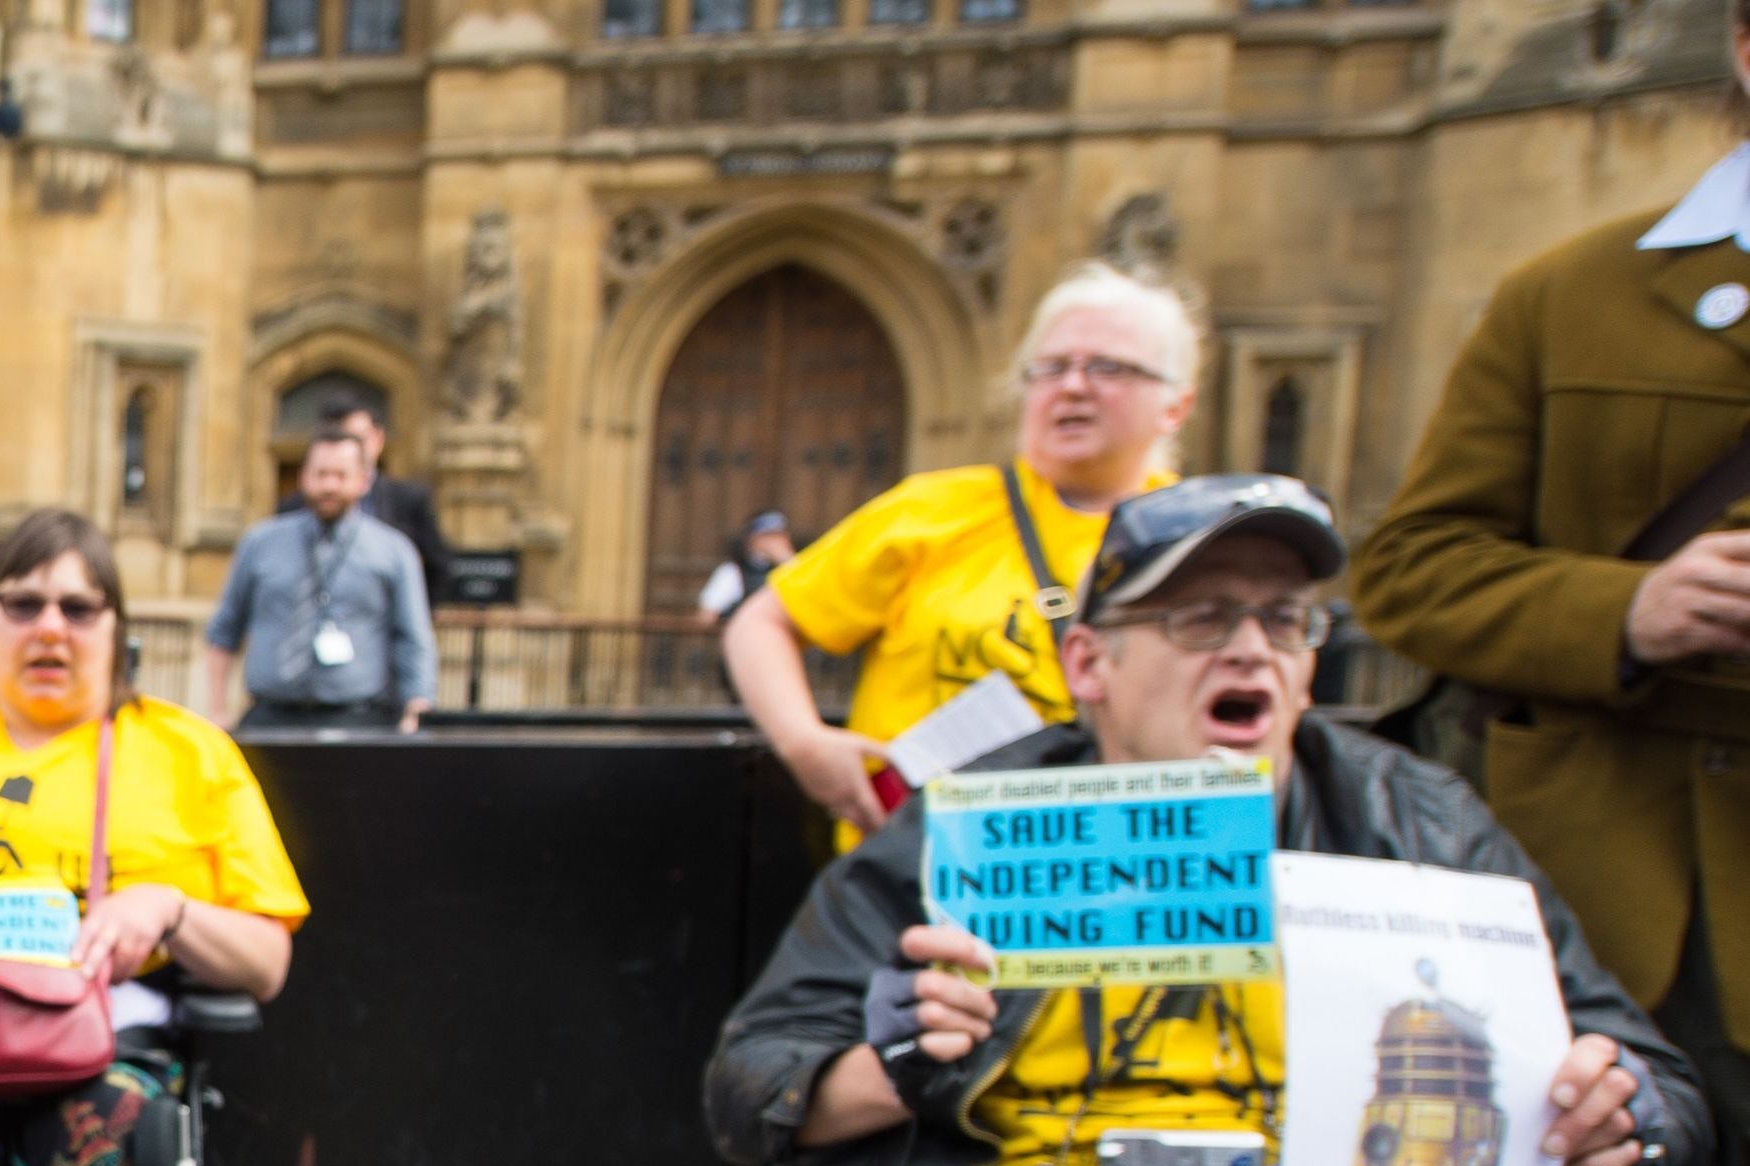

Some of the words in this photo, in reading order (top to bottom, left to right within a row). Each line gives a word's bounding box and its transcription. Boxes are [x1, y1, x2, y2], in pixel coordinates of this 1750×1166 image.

[1000, 774, 1061, 799] disabled
[1067, 773, 1122, 800] people
[1159, 768, 1194, 791] their
[1200, 765, 1262, 789] families
[982, 810, 1099, 851] SAVE
[1123, 803, 1208, 842] THE
[936, 852, 1268, 901] INDEPENDENT
[968, 907, 1103, 948] IVING
[1135, 905, 1261, 942] FUND
[1025, 955, 1094, 979] because
[1147, 950, 1193, 974] worth
